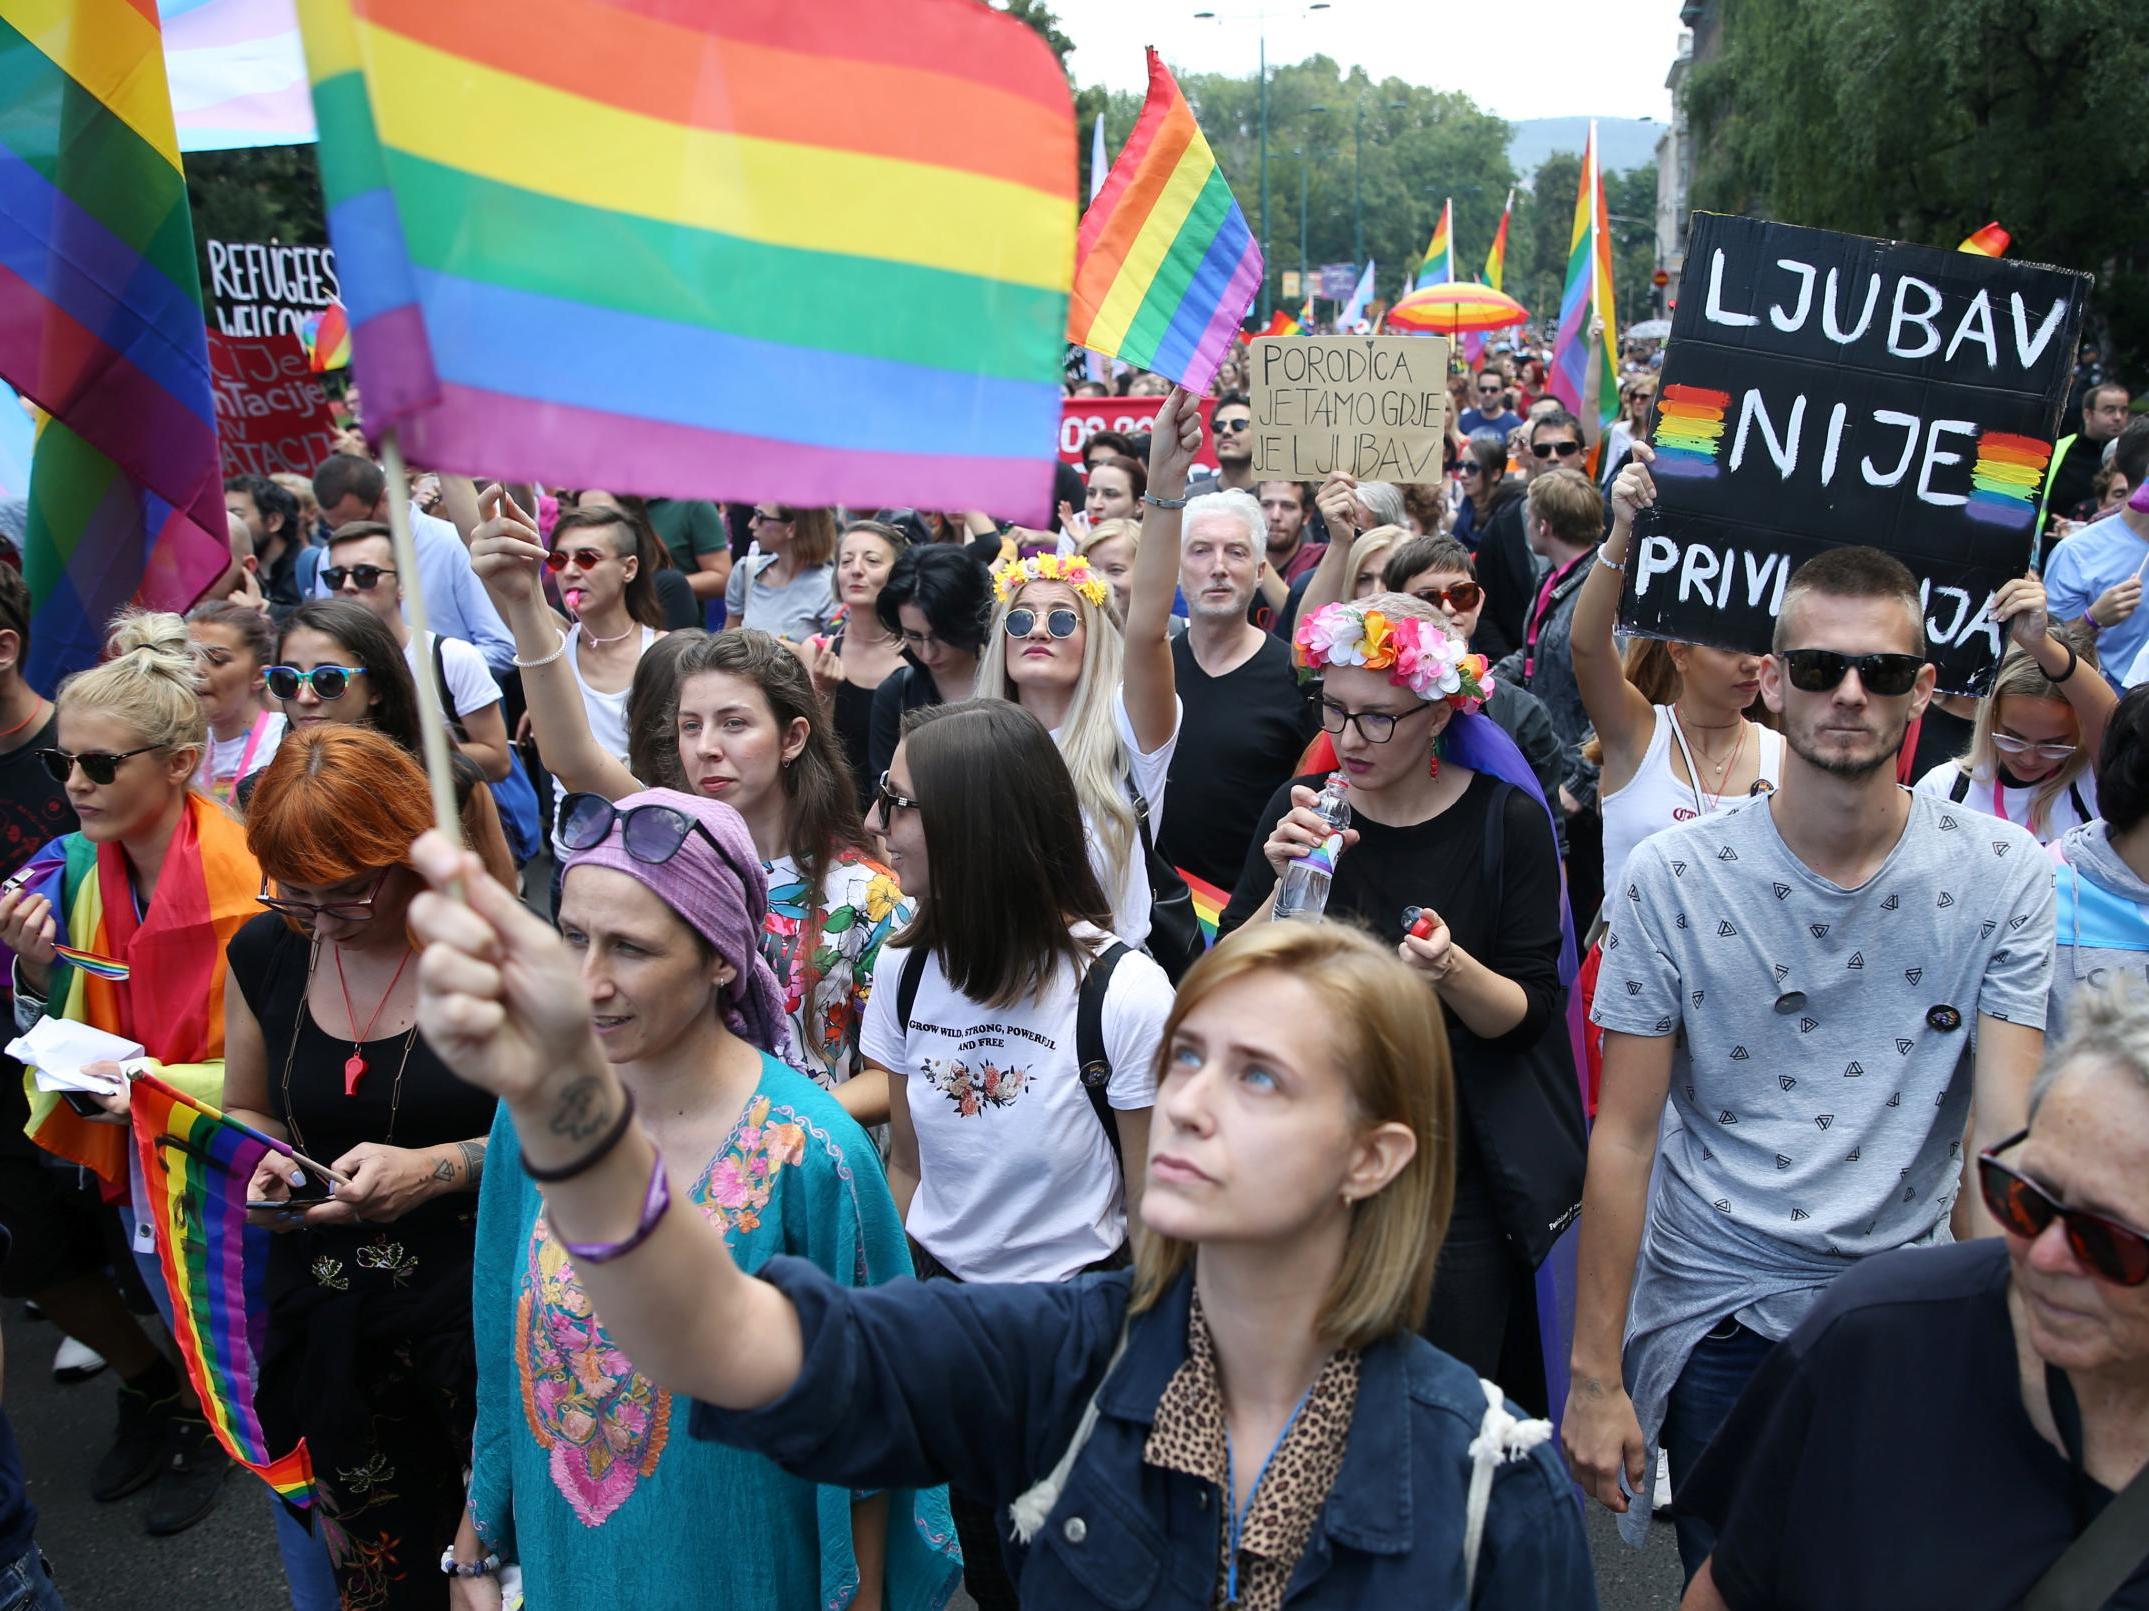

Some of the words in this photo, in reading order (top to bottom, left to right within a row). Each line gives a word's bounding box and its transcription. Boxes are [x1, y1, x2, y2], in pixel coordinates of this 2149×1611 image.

[207, 239, 341, 306] REFUGEES
[1705, 247, 2068, 369] LJUBAV
[1264, 341, 1413, 386] PORODICA
[1258, 388, 1293, 426] JE
[1295, 388, 1376, 427] TAMO
[1381, 390, 1441, 428] GDJE
[1252, 434, 1282, 472] JE
[1293, 433, 1437, 480] LJUBAV
[1728, 388, 1978, 506] NIJE
[1634, 535, 2001, 660] PRIVIIJA
[908, 1019, 940, 1034] GROW
[940, 1026, 964, 1039] WILD,
[964, 1023, 1005, 1037] STRONG,
[957, 1040, 976, 1052] AND
[977, 1037, 1005, 1048] FREE
